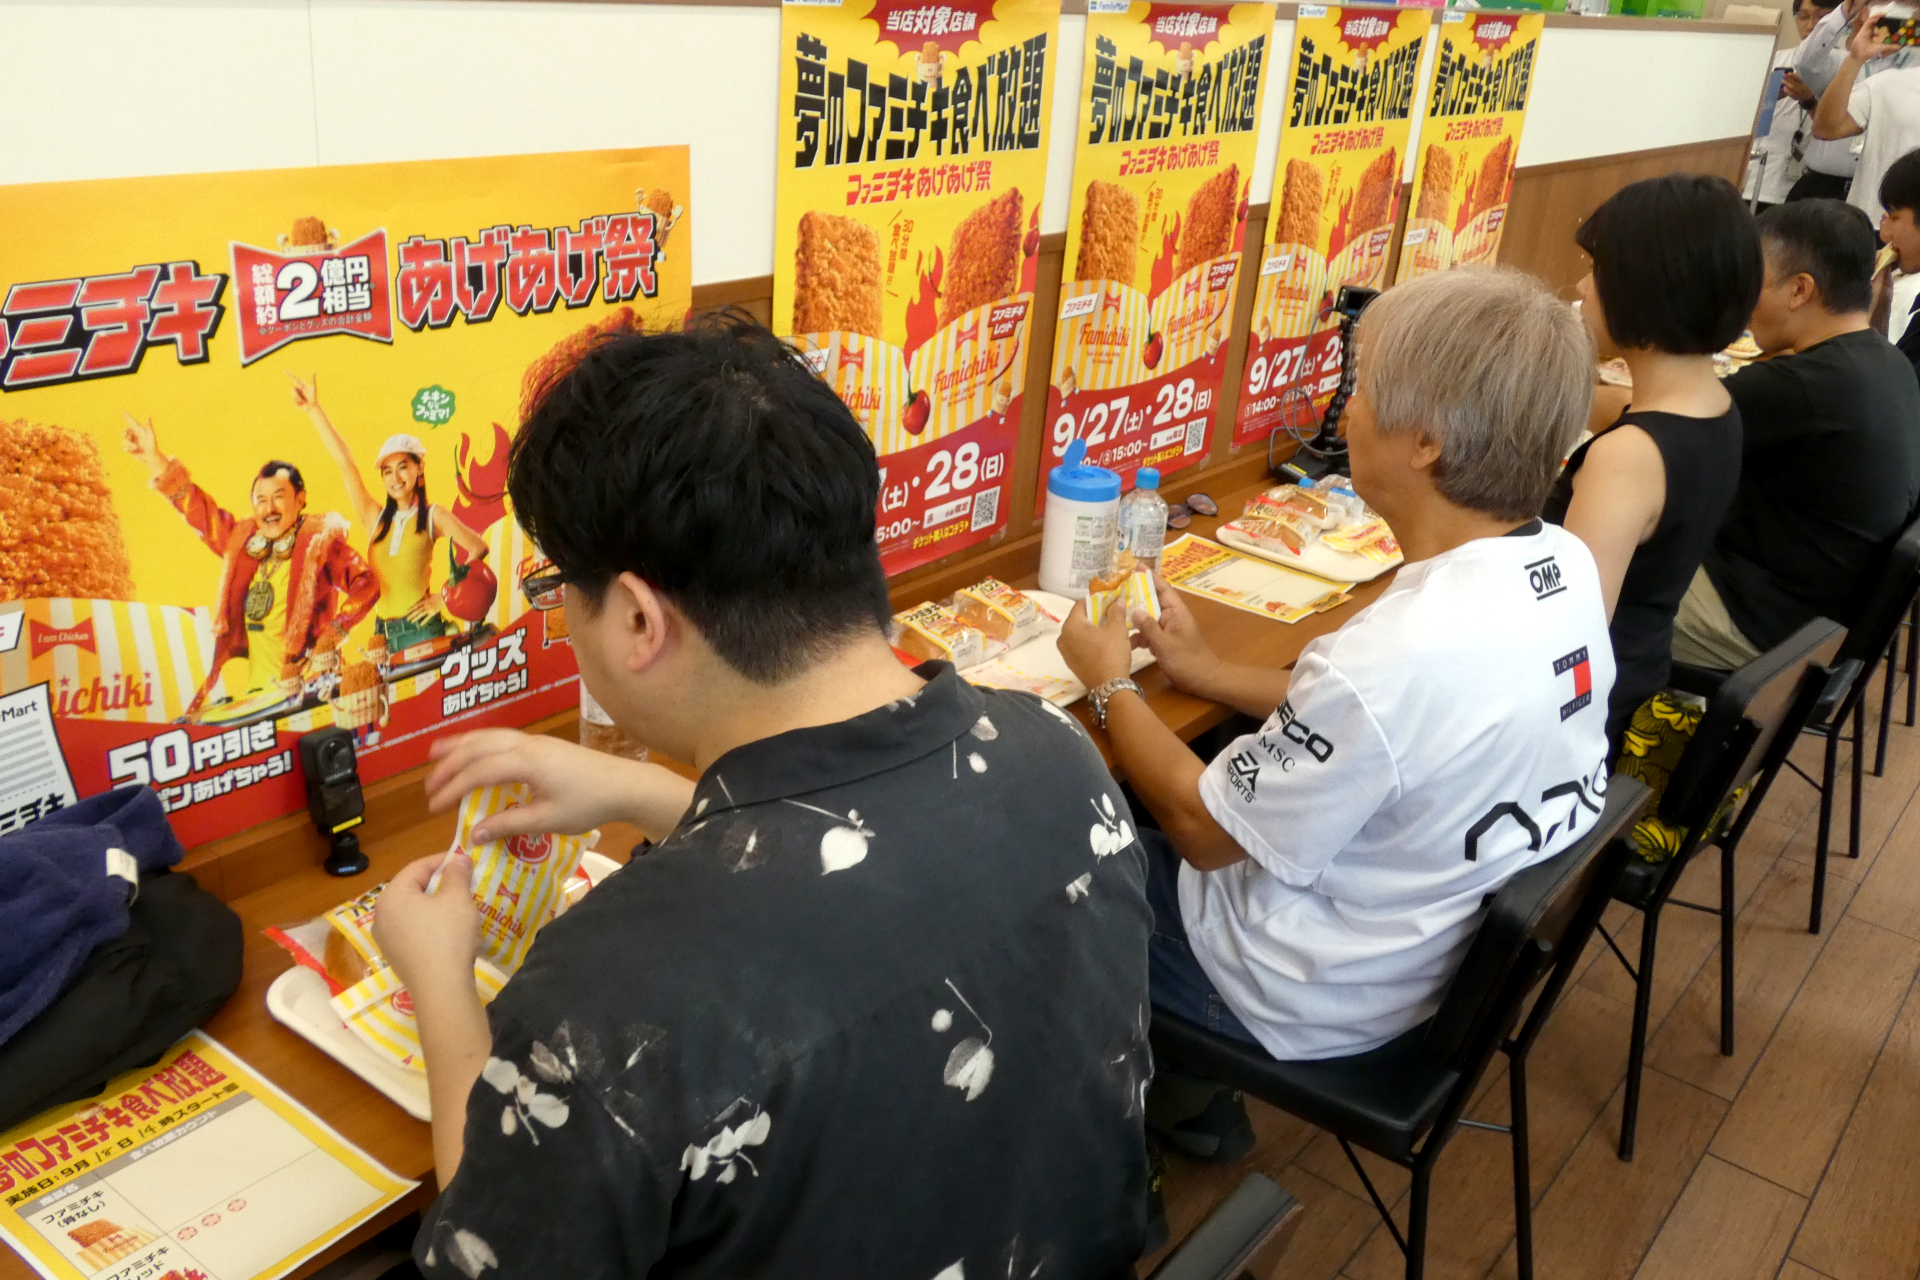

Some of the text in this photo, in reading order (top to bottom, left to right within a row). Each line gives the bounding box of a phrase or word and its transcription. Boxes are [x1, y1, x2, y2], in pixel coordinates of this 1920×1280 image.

[886, 6, 977, 35] 当店対象店舗
[1156, 12, 1218, 37] 当店対象店舗
[794, 31, 1048, 169] 夢のファミチキ食べ放題
[1088, 34, 1266, 145] 夢のファミチキ食べ放題
[1290, 35, 1423, 128] 夢のファミチキ食べ放題
[1119, 140, 1221, 176] ファミチキあげあげ祭
[846, 160, 992, 206] ファミチキあげあげ祭
[396, 212, 660, 331] あげあげ祭
[991, 304, 1025, 322] ファミチキ
[1079, 322, 1132, 347] Famichiki
[934, 344, 1001, 394] Famichiki
[1529, 563, 1562, 593] OMP
[441, 627, 527, 690] グッズ
[1556, 650, 1588, 672] TOMMY
[443, 668, 528, 717] あげちゃう!
[1562, 694, 1591, 718] HILFIGER
[108, 720, 278, 791] 50円引き
[1230, 750, 1261, 793] EA
[1258, 734, 1296, 772] MSC
[1227, 760, 1256, 804] SPORTS
[42, 1190, 105, 1224] ファミチキ
